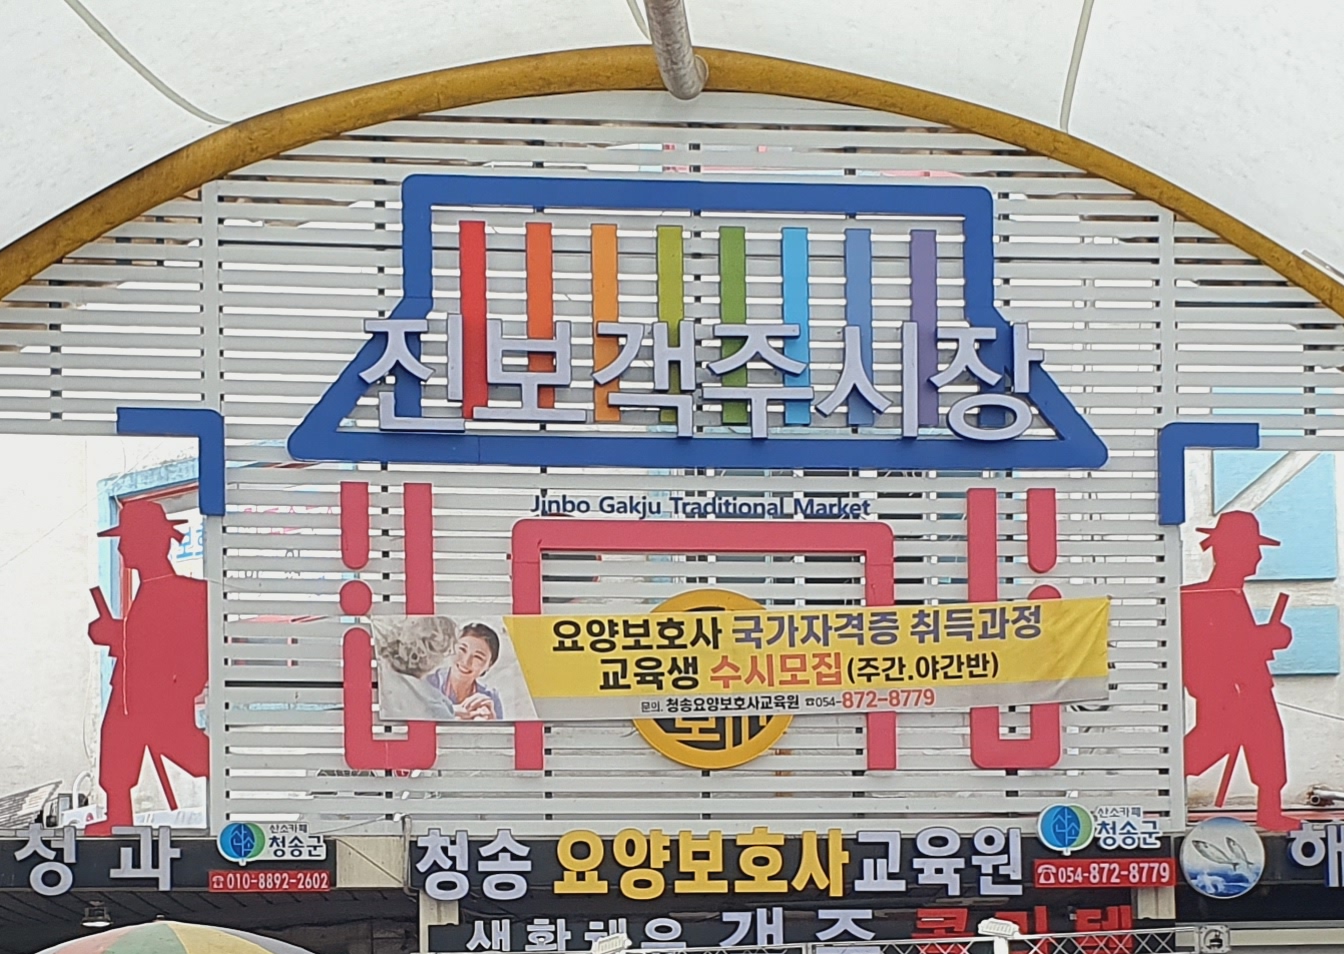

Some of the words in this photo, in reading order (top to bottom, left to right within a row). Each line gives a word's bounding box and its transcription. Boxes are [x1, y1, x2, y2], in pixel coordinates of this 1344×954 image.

[359, 311, 1045, 441] 진보객주시장
[530, 495, 590, 516] Jinbo
[599, 495, 662, 519] Gakju
[669, 496, 785, 517] Traditional
[793, 498, 871, 518] Market
[552, 617, 723, 653] 요양보호사
[732, 610, 900, 650] 국가자격증
[909, 604, 1042, 644] 취득과정
[599, 655, 700, 691] 교육생
[710, 652, 843, 689] 수시모집
[847, 651, 999, 684] (주간.야간반)
[666, 694, 800, 713] 청송요양보호사교육원
[816, 688, 936, 709] 054-872-8779
[1096, 806, 1142, 818] 산소카페
[268, 824, 307, 833] 산소카페
[1094, 820, 1162, 849] 청송군
[268, 835, 324, 858] 청송군
[416, 827, 532, 901] 청송
[553, 826, 1024, 900] 요양보호사교육원
[1058, 861, 1171, 885] 054-872-8779
[226, 873, 328, 889] 010-8892-2602
